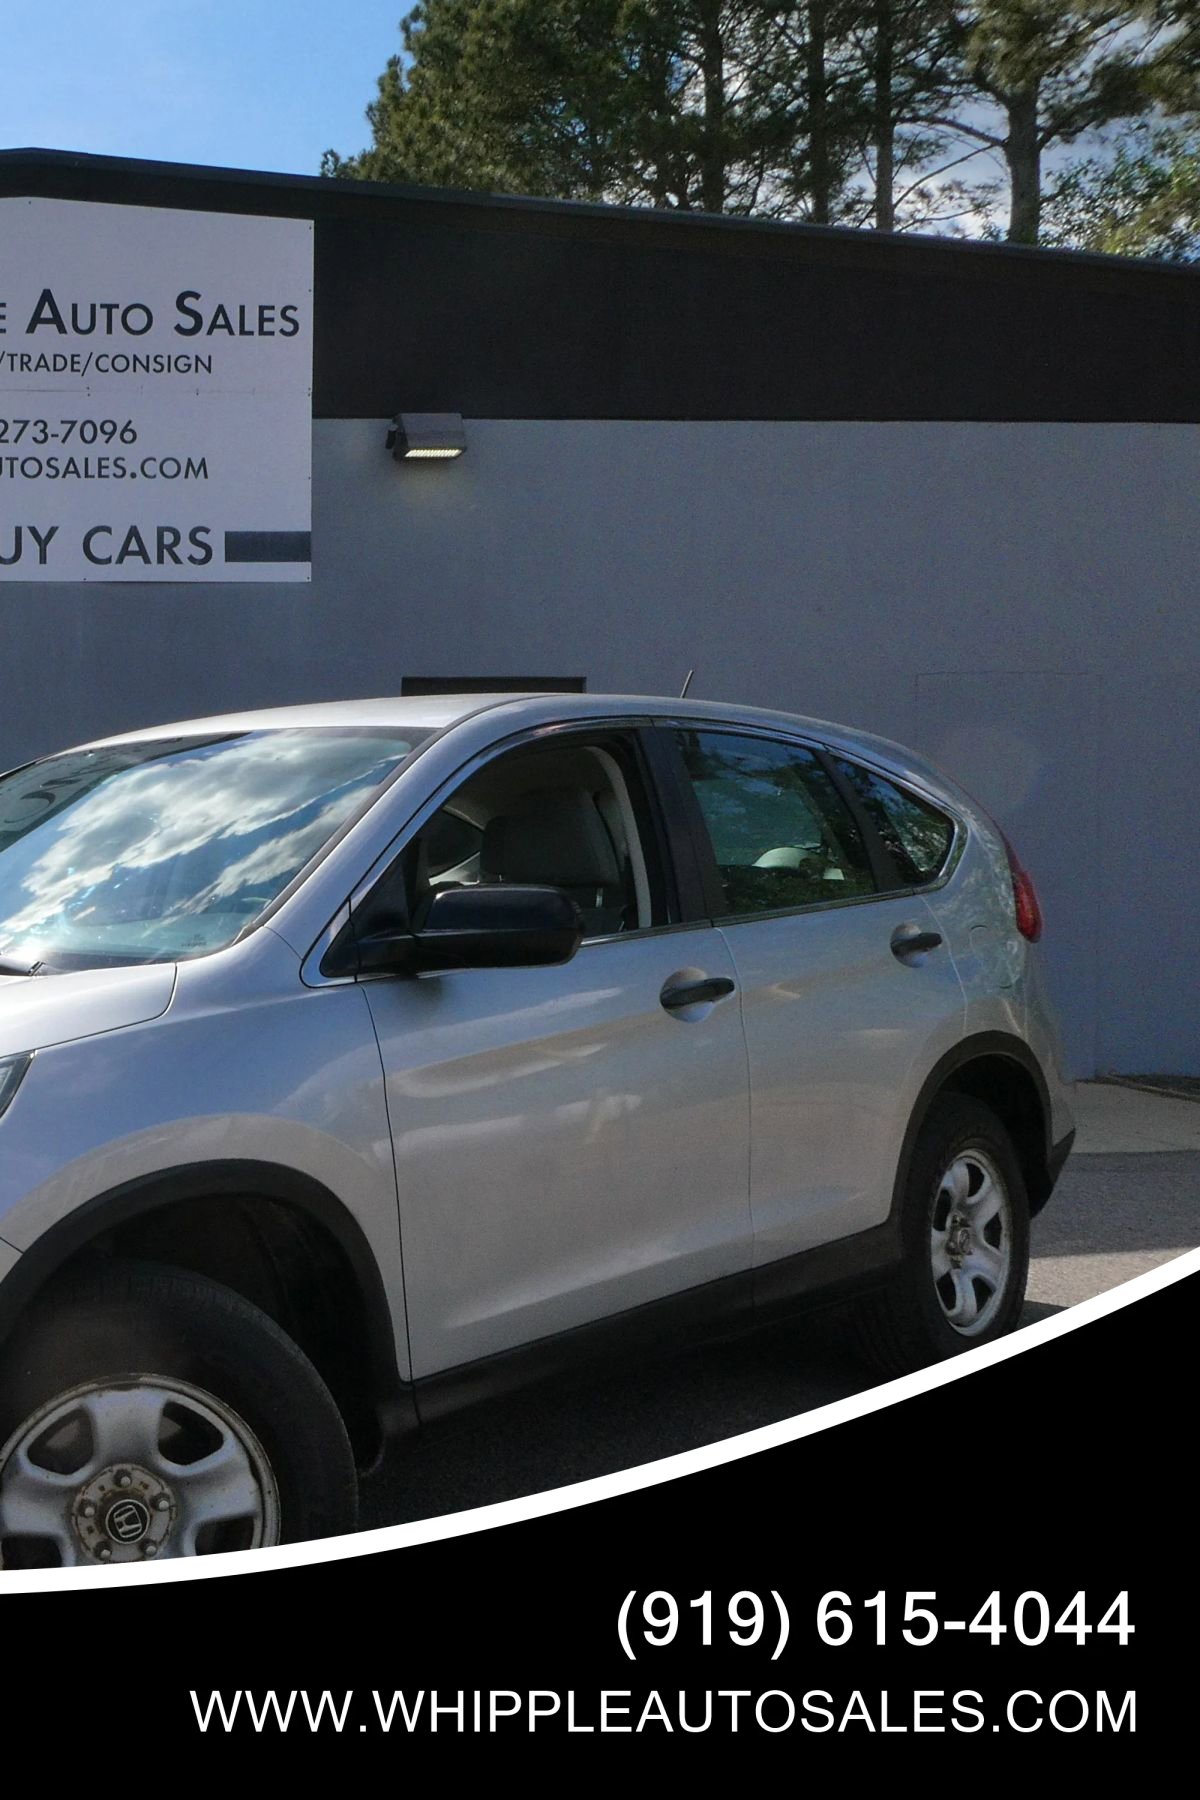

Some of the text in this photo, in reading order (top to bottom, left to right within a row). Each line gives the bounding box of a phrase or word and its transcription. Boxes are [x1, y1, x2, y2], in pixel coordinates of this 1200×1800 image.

[26, 288, 154, 336] AUTO
[174, 290, 301, 337] SALES
[82, 524, 214, 566] CARS
